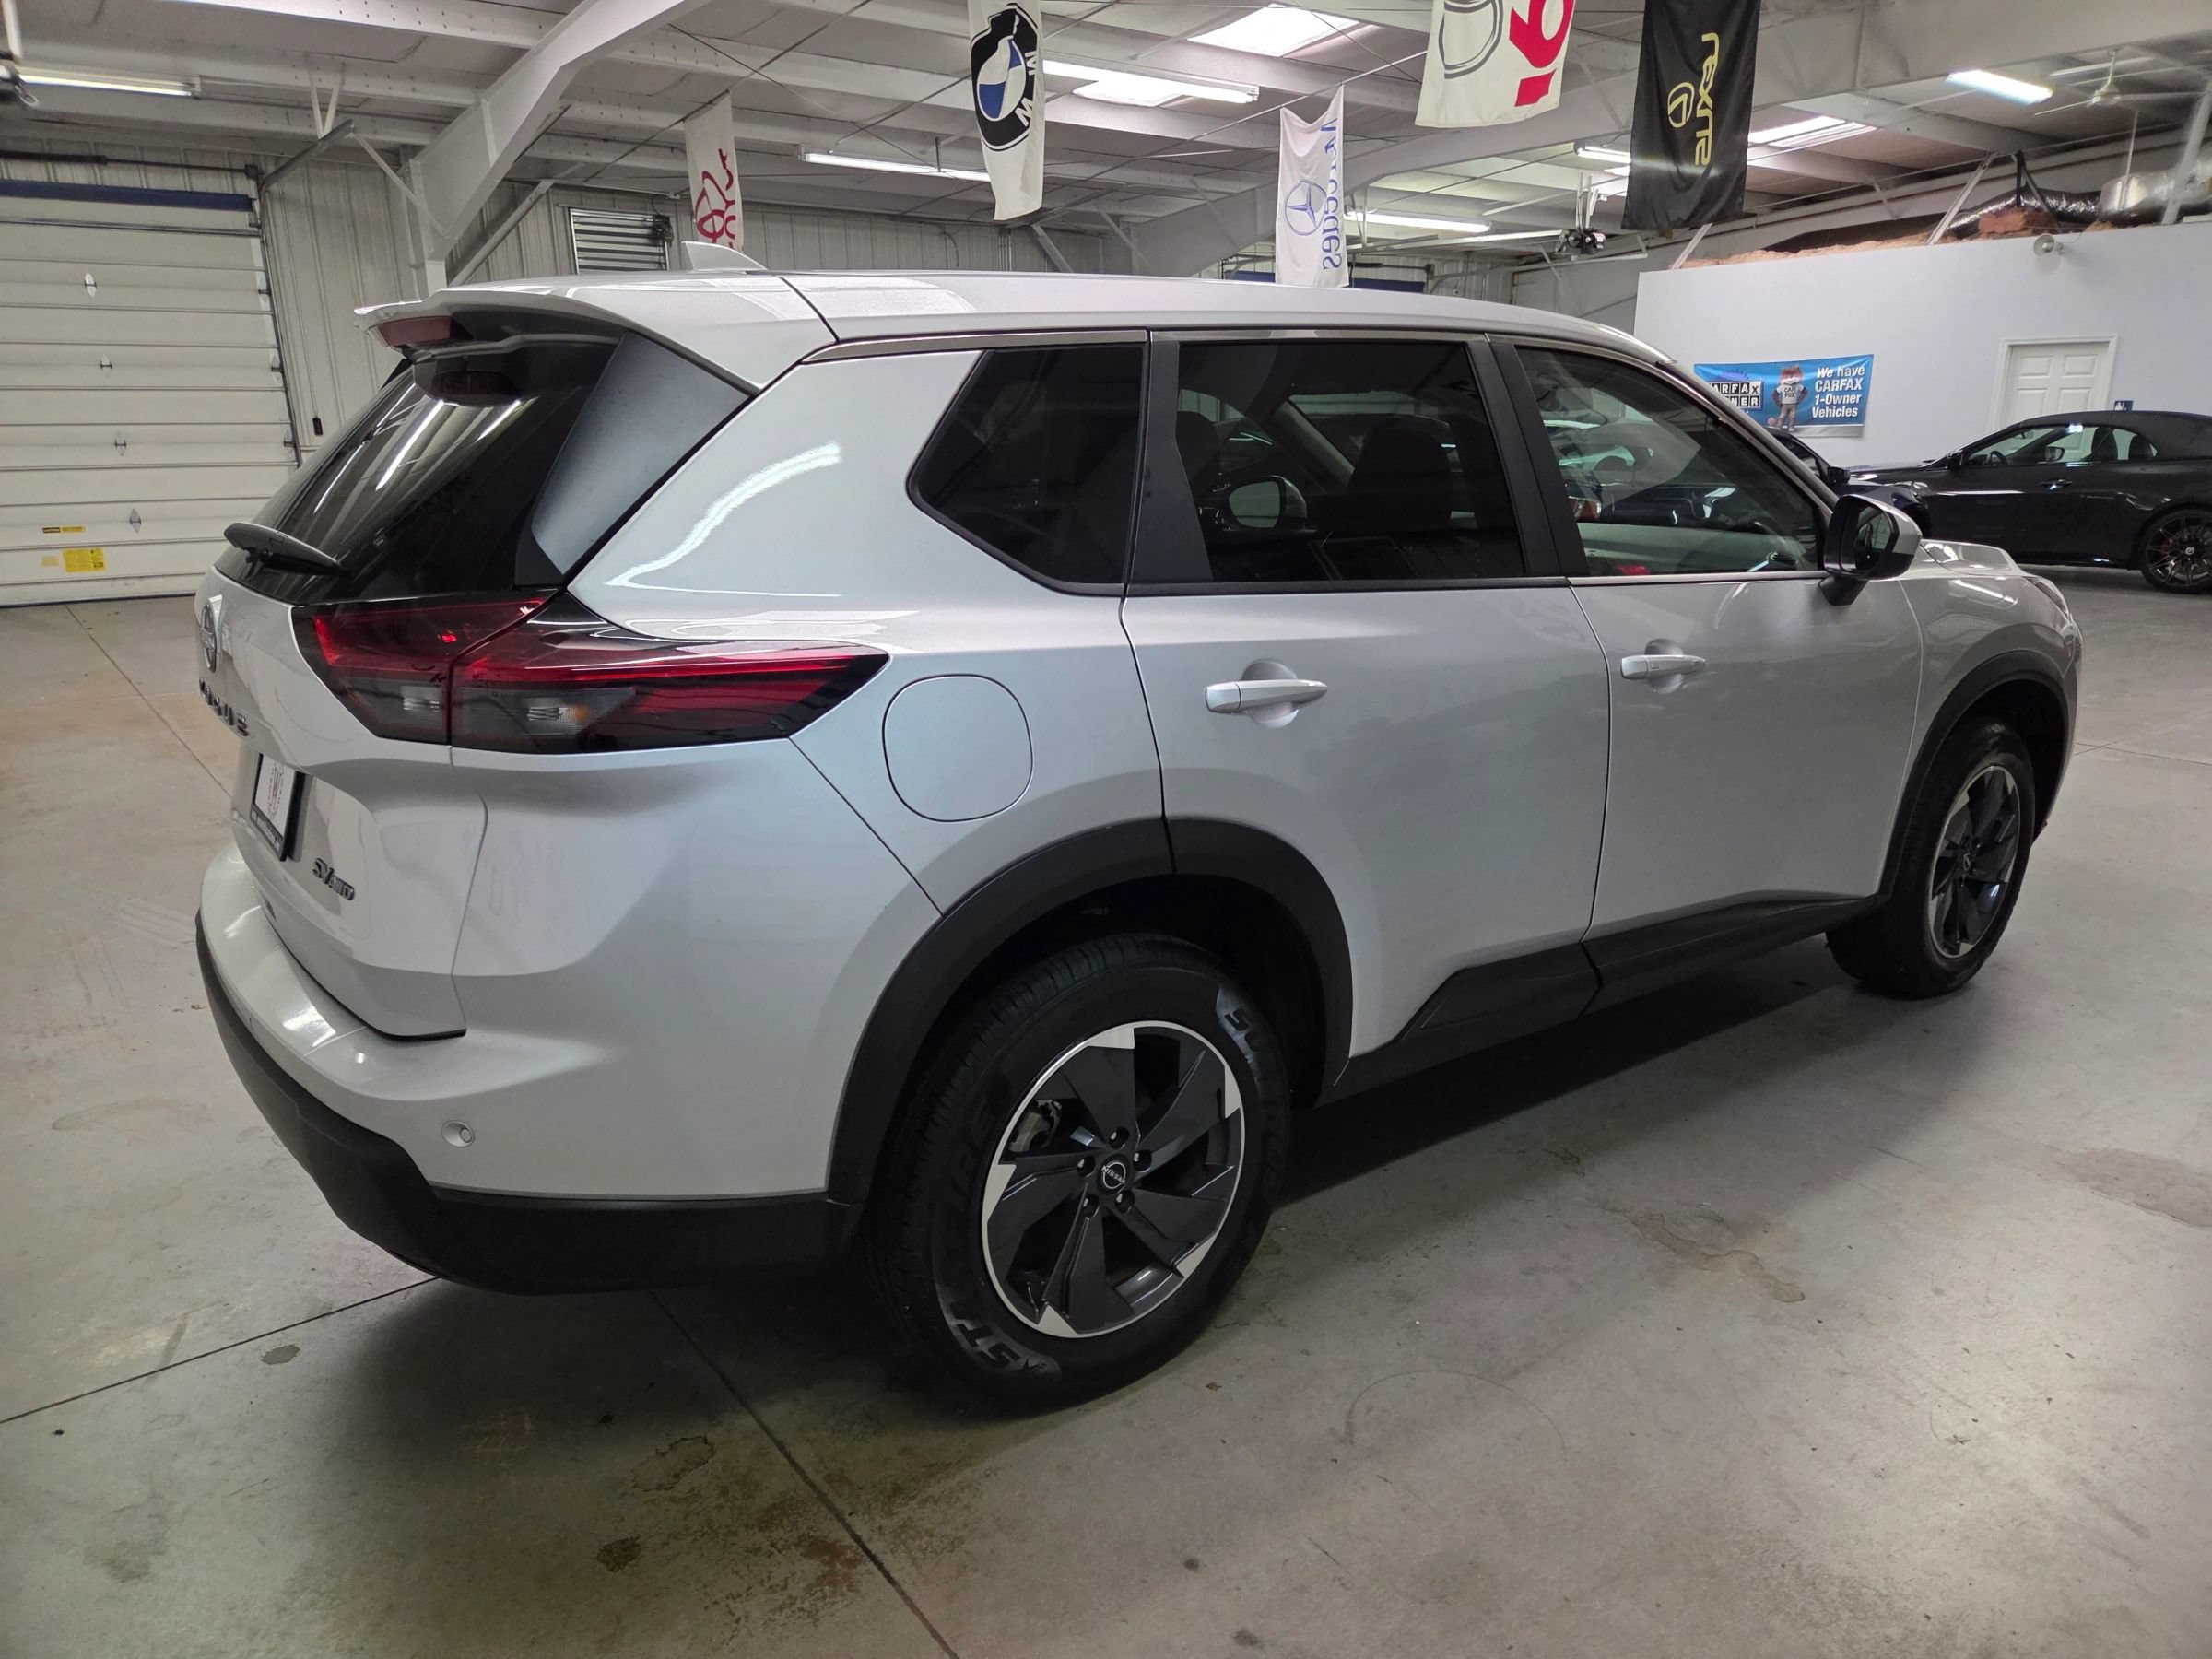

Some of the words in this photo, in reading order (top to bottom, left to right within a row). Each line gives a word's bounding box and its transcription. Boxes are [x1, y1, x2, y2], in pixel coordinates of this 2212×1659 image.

[1817, 368, 1834, 378] We
[1837, 366, 1865, 377] have
[1713, 383, 1759, 394] ARFAX
[1815, 378, 1863, 393] CARFAX
[1815, 394, 1862, 405] 1-Owner
[1812, 406, 1858, 418] Vehicles
